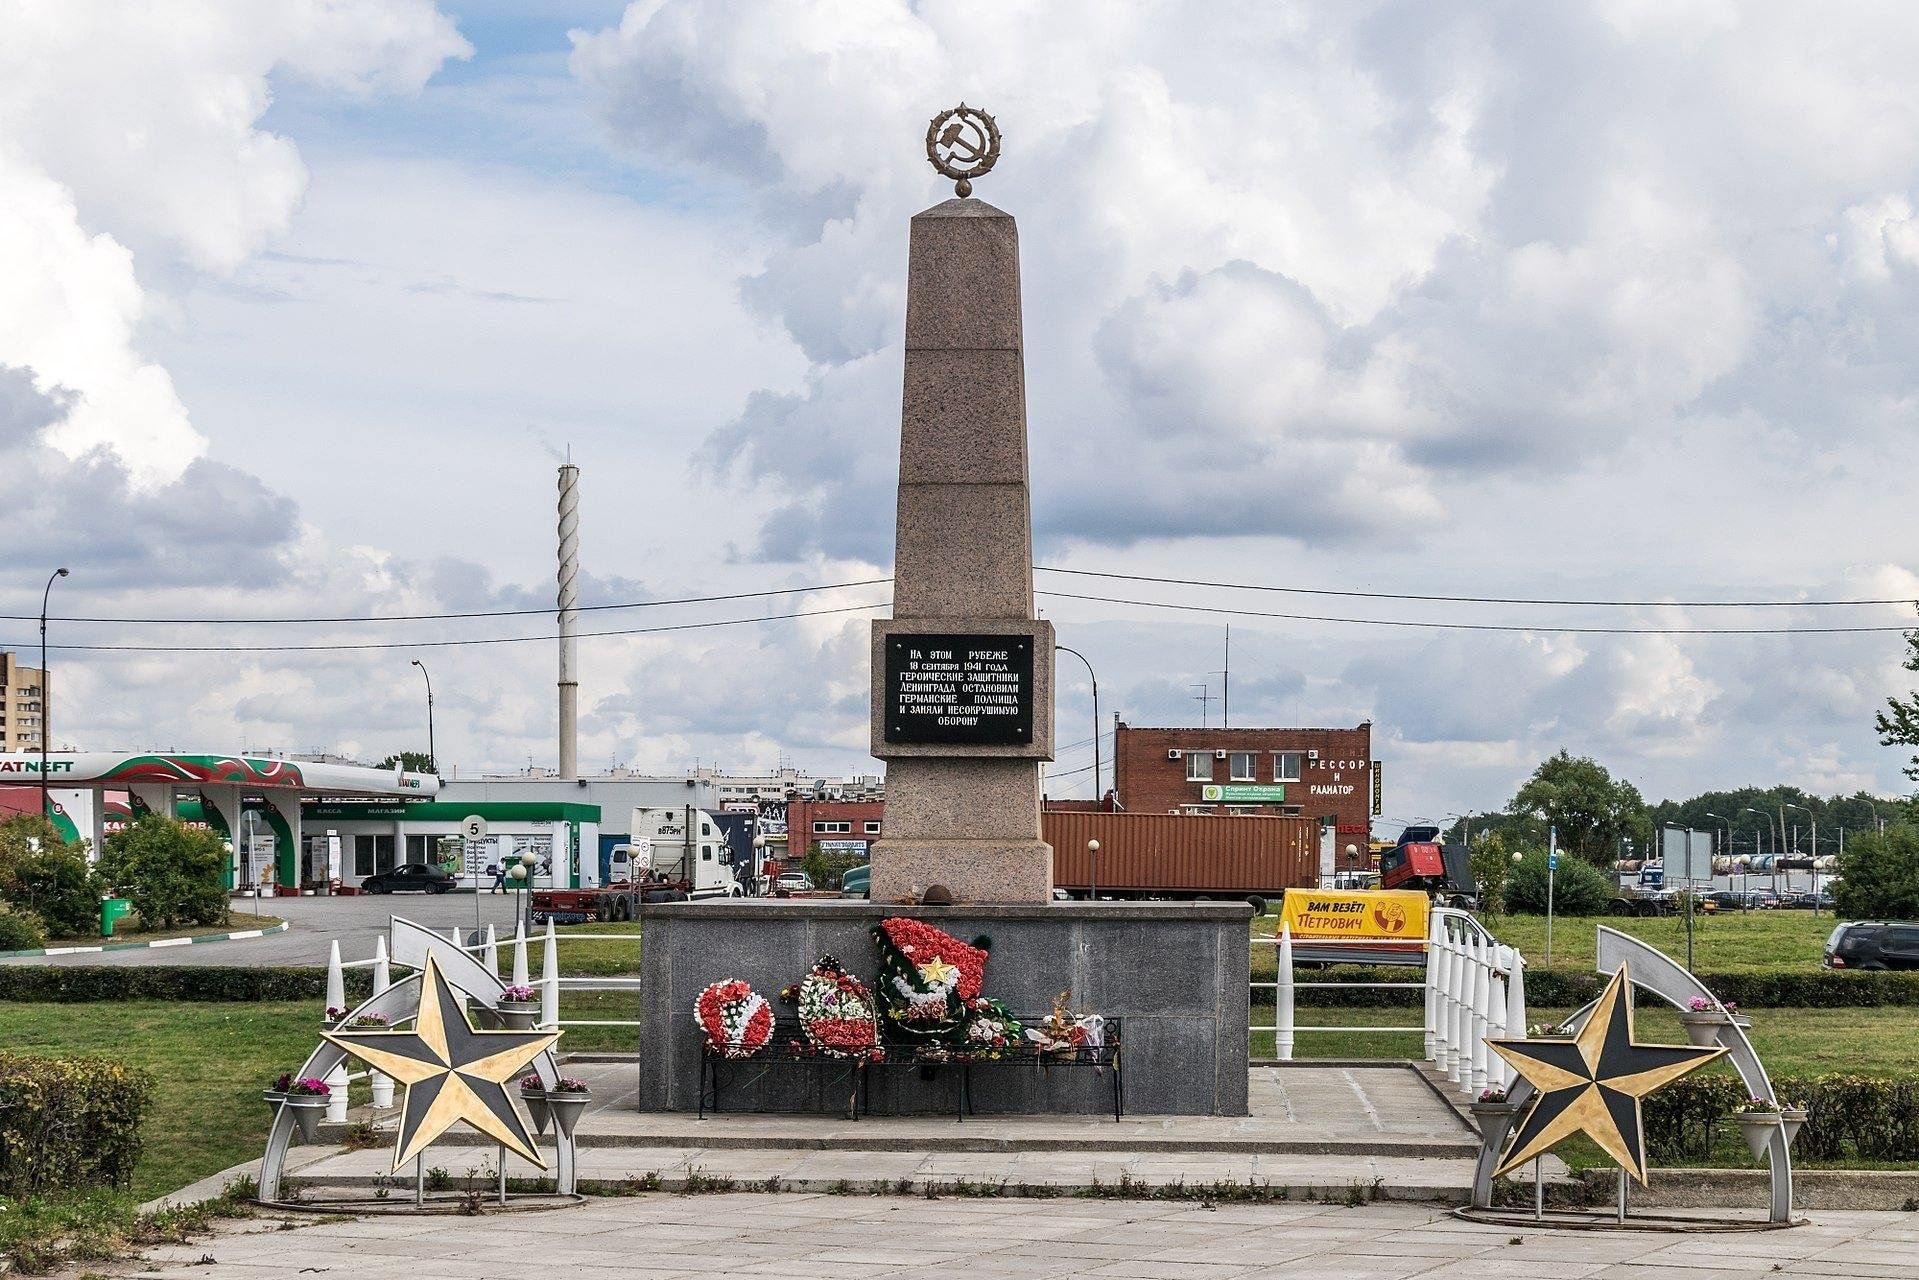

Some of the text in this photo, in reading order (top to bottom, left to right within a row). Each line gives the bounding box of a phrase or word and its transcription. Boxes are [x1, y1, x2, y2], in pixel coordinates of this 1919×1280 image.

[910, 650, 1009, 661] НА ЭТОМ РУБЕЖЕ
[909, 661, 1008, 672] 18 СЕНТЯБРЯ 1941 ГОДА
[899, 672, 1019, 683] ГЕРОИЧЕСКИЕ ЗАЩИТНИКИ
[900, 683, 1019, 693] ЛЕНИНГРАДА ОСТАНОВИЛИ
[899, 694, 1018, 705] ГЕРМАНСКИЕ ПОЛЧИЩА
[899, 705, 1018, 716] И ЗАНЯЛИ НЕСОКРУШИМУЮ
[938, 716, 979, 726] ОБОРОНУ
[0, 761, 74, 772] ATNEFT
[1310, 760, 1365, 770] РЕССОР
[1310, 785, 1354, 795] РАДИАТОР
[469, 823, 479, 835] 5
[1307, 901, 1366, 913] ВАМ ВЕЗЁТ!
